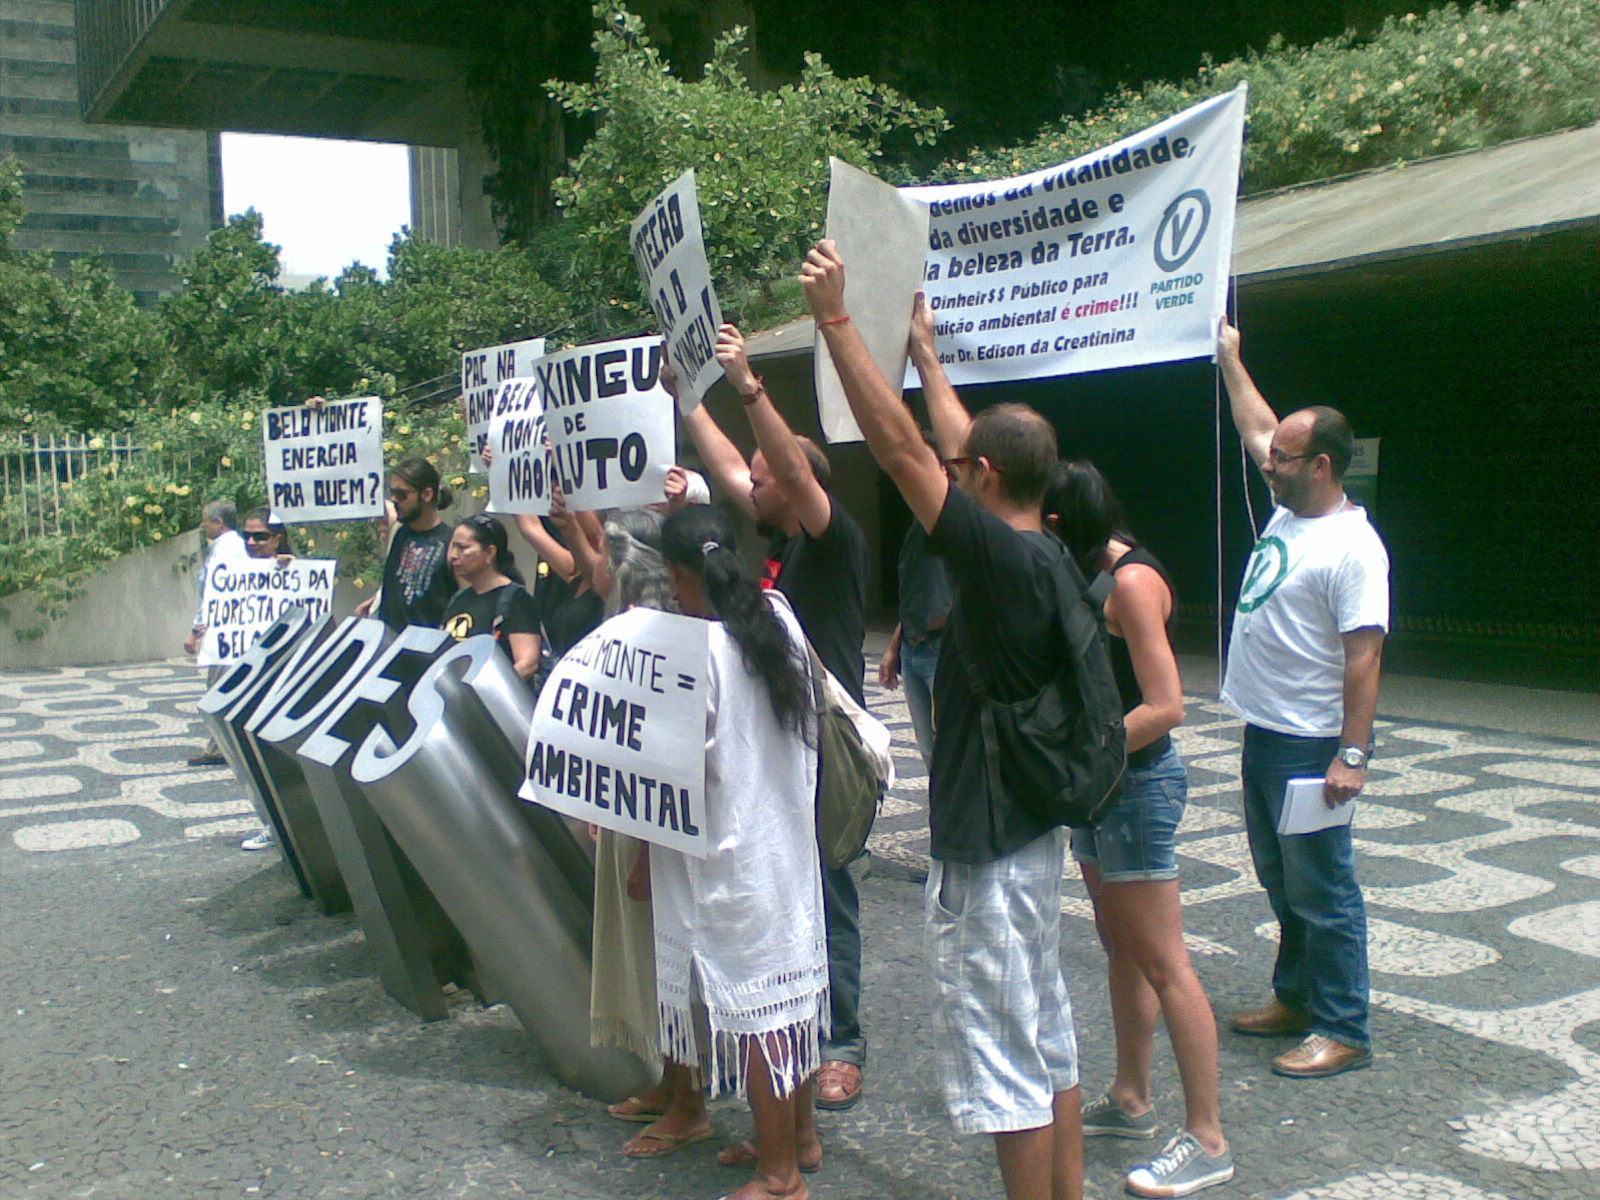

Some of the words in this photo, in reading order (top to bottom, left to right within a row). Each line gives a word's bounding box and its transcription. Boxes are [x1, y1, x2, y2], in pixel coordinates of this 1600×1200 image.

[929, 228, 954, 251] da
[957, 198, 1099, 246] diversidade
[1108, 193, 1125, 213] e
[948, 251, 1023, 279] beleza
[1031, 241, 1060, 265] da
[1067, 226, 1135, 258] Terra.
[1010, 279, 1068, 301] Público
[1072, 271, 1109, 295] para
[1150, 273, 1204, 295] PARTIDO
[1155, 291, 1196, 311] VERDE
[978, 306, 1057, 332] ambiental
[1061, 301, 1071, 320] é
[1075, 291, 1139, 319] crime!!!
[937, 351, 956, 365] dor
[957, 348, 975, 363] Dr.
[978, 344, 1025, 361] Edison
[1030, 338, 1049, 354] da
[1054, 328, 1136, 352] Creatinina
[465, 354, 488, 389] PAC
[497, 349, 516, 382] NA
[537, 346, 661, 412] XINGU
[496, 382, 537, 417] BELO
[268, 406, 310, 440] BELO
[316, 401, 373, 434] MONTE,
[501, 414, 548, 454] MONTE
[564, 413, 586, 435] DE
[282, 442, 357, 471] ENERGIA
[509, 450, 551, 501] NÃO!
[555, 432, 648, 495] LUTO
[273, 481, 304, 508] PRA
[309, 569, 329, 590] DA
[207, 594, 274, 628] FLORESTA
[594, 638, 667, 695] MONTE
[196, 605, 497, 783] BNDES
[552, 678, 646, 752] CRIME
[529, 741, 700, 836] AMBIENTAL
